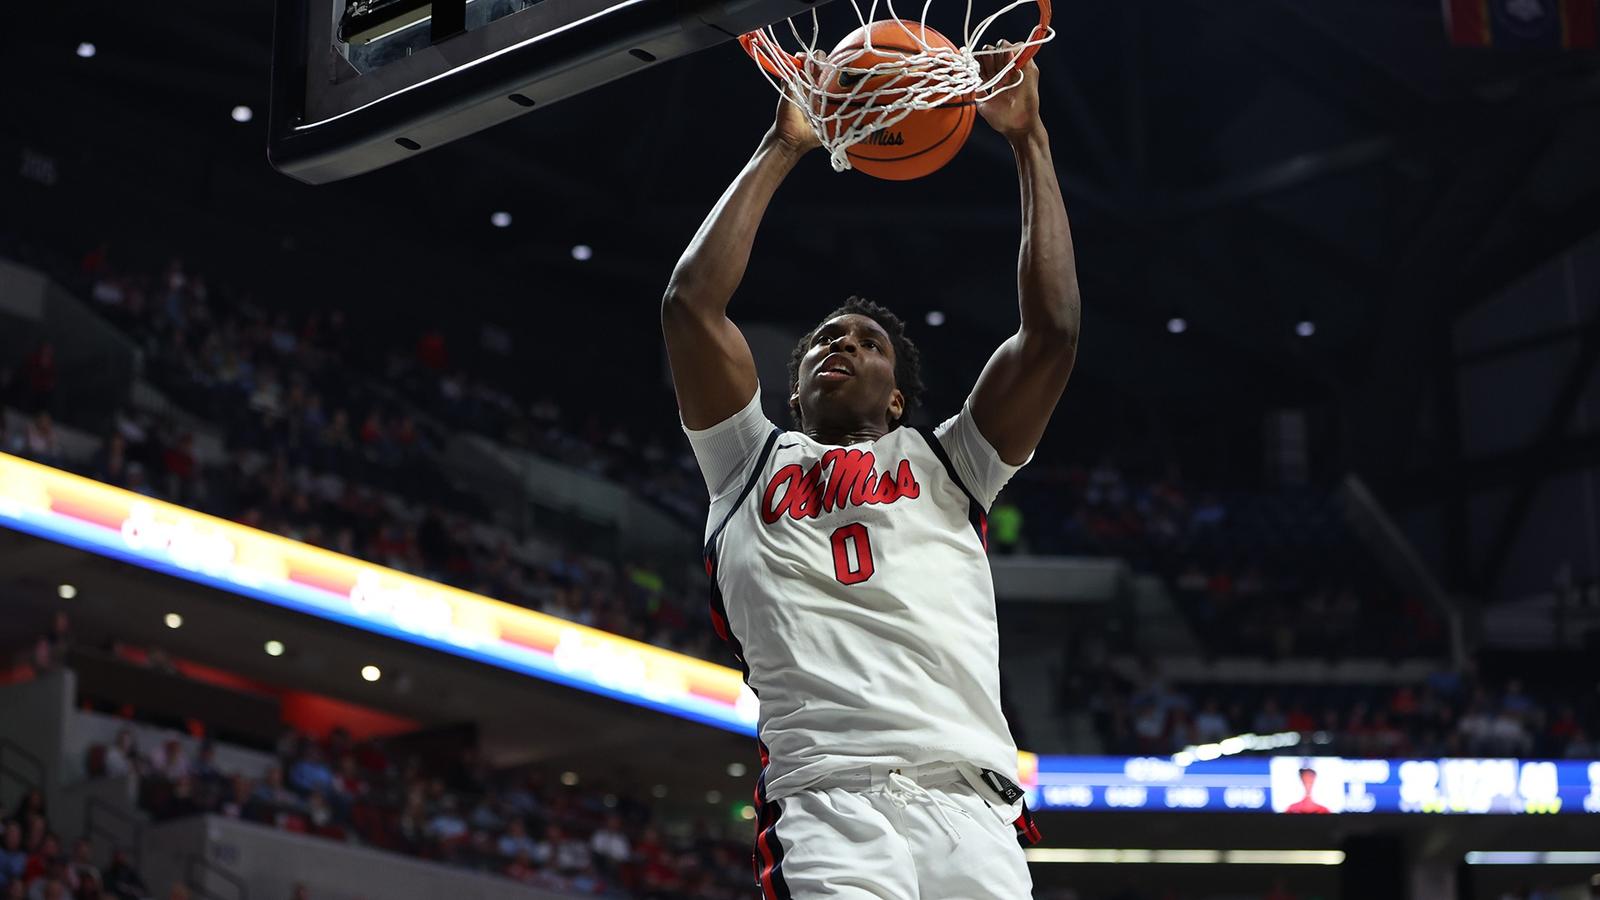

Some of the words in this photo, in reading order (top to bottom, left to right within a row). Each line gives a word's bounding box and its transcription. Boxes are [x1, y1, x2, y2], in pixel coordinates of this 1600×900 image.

[762, 460, 826, 524] Ole
[821, 449, 920, 511] Miss
[829, 522, 875, 586] 0
